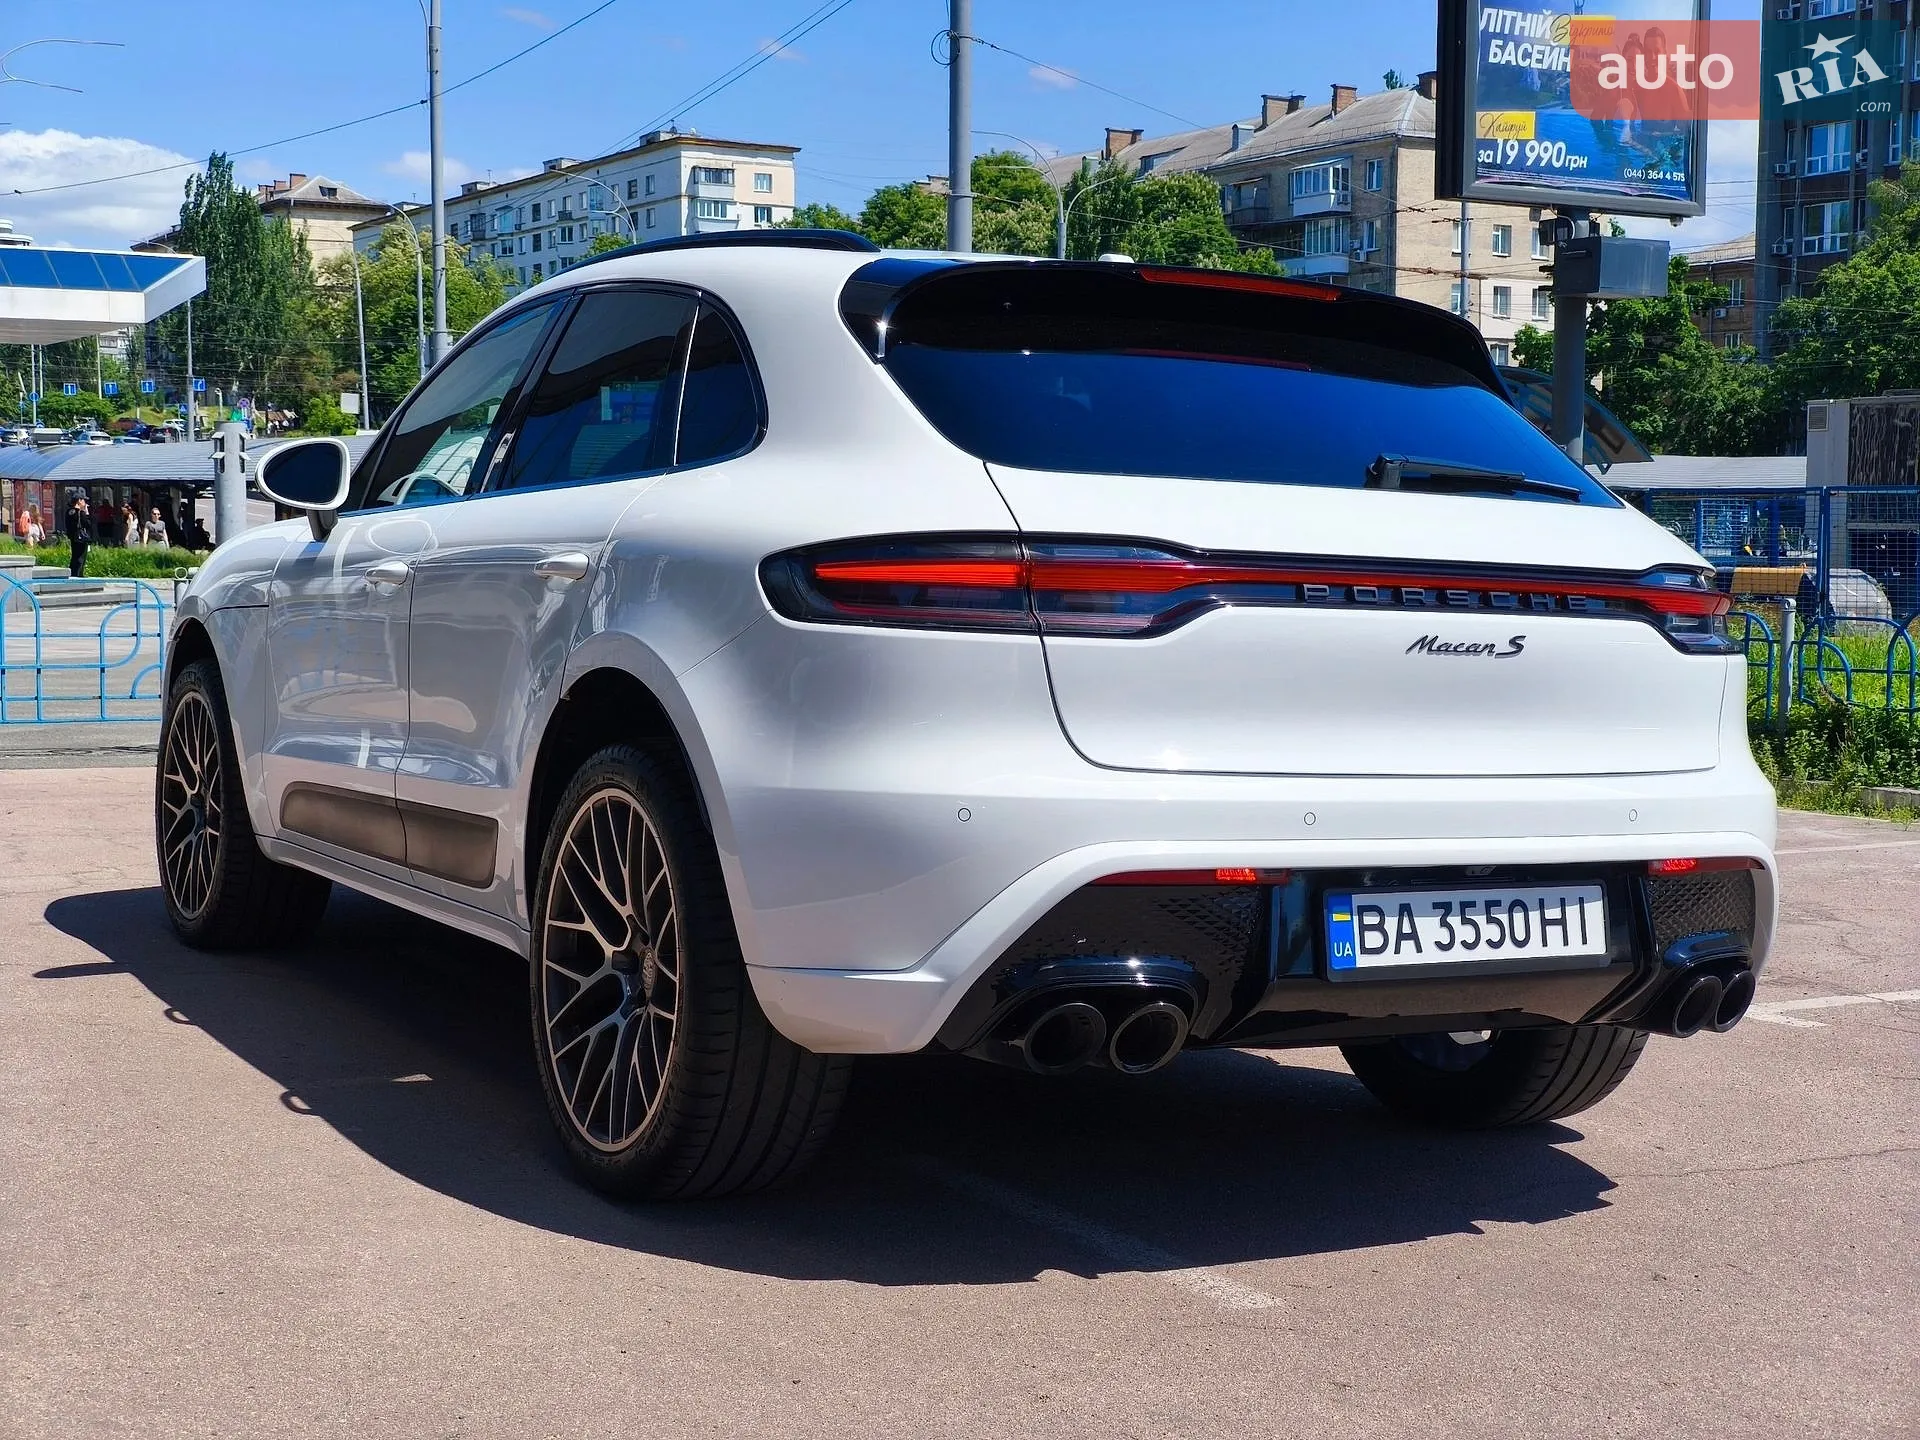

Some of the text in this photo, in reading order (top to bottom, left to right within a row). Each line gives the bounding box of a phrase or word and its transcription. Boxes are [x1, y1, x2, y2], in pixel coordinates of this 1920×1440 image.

[1479, 7, 1553, 39] ЛІТНІЙ
[1488, 39, 1571, 71] БАСЕЙН
[1565, 155, 1588, 171] грн
[1623, 168, 1645, 180] (044)
[1303, 584, 1590, 611] PORSCHE
[1405, 634, 1527, 659] Macan S
[1334, 942, 1353, 957] UA
